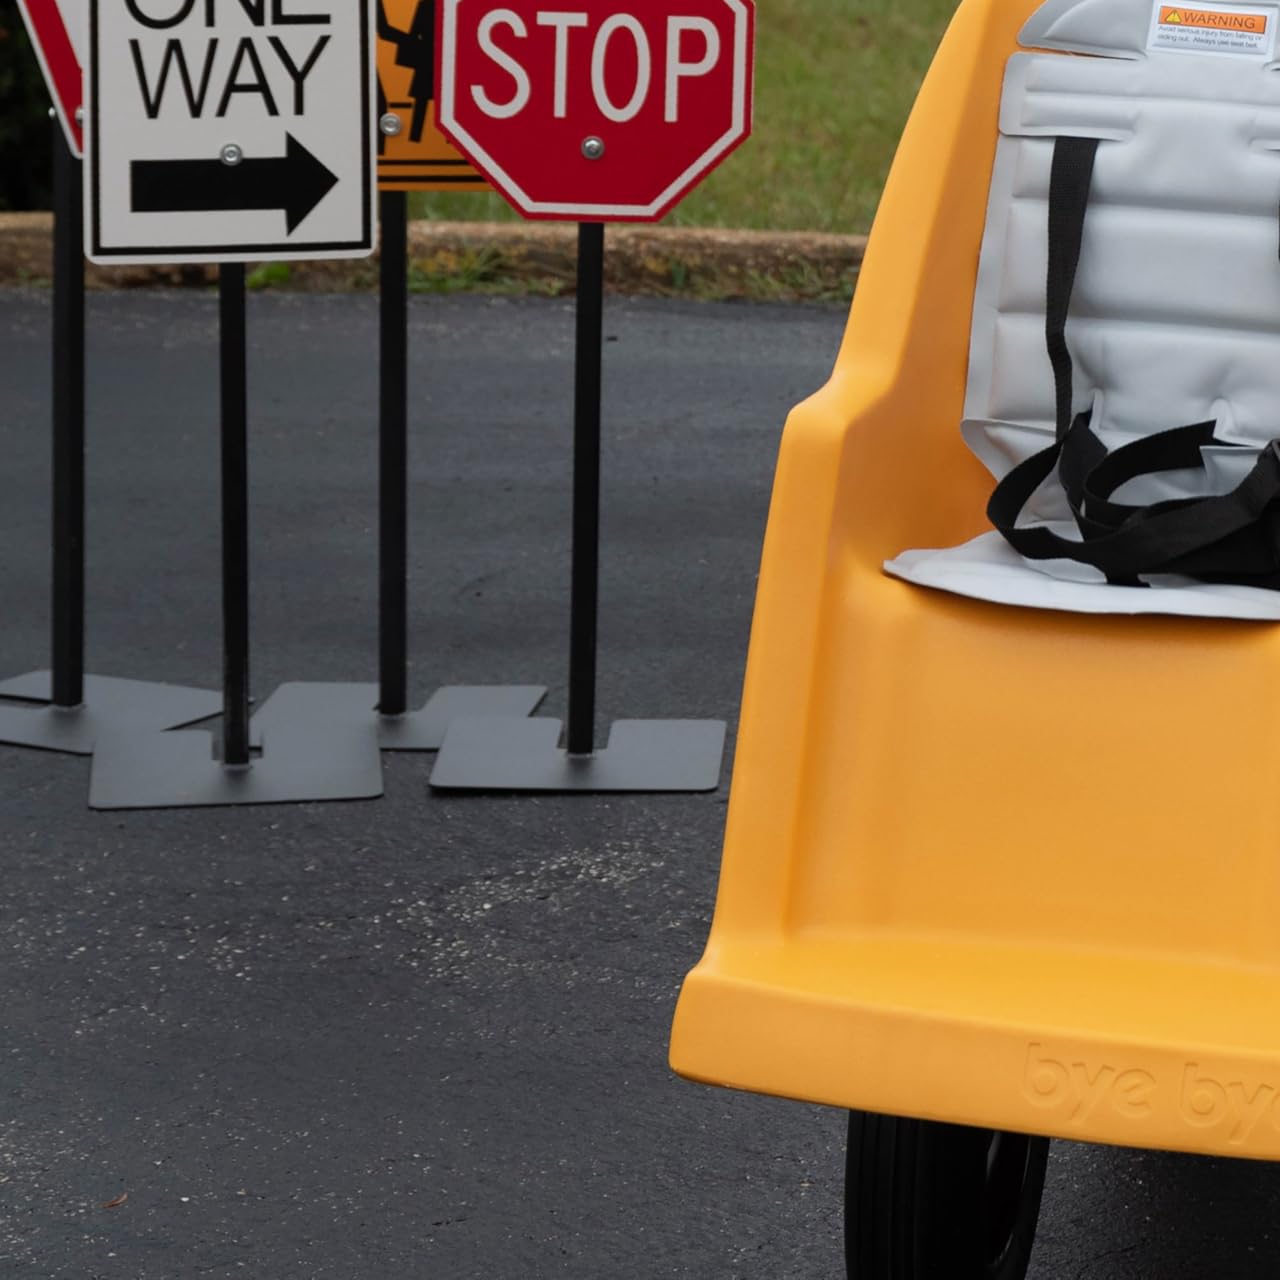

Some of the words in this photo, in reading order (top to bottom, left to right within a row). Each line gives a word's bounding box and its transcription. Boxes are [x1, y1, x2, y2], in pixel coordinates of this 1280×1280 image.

[1184, 11, 1256, 29] WARNING
[129, 35, 331, 119] WAY
[470, 9, 721, 123] STOP
[1021, 1042, 1157, 1125] bye
